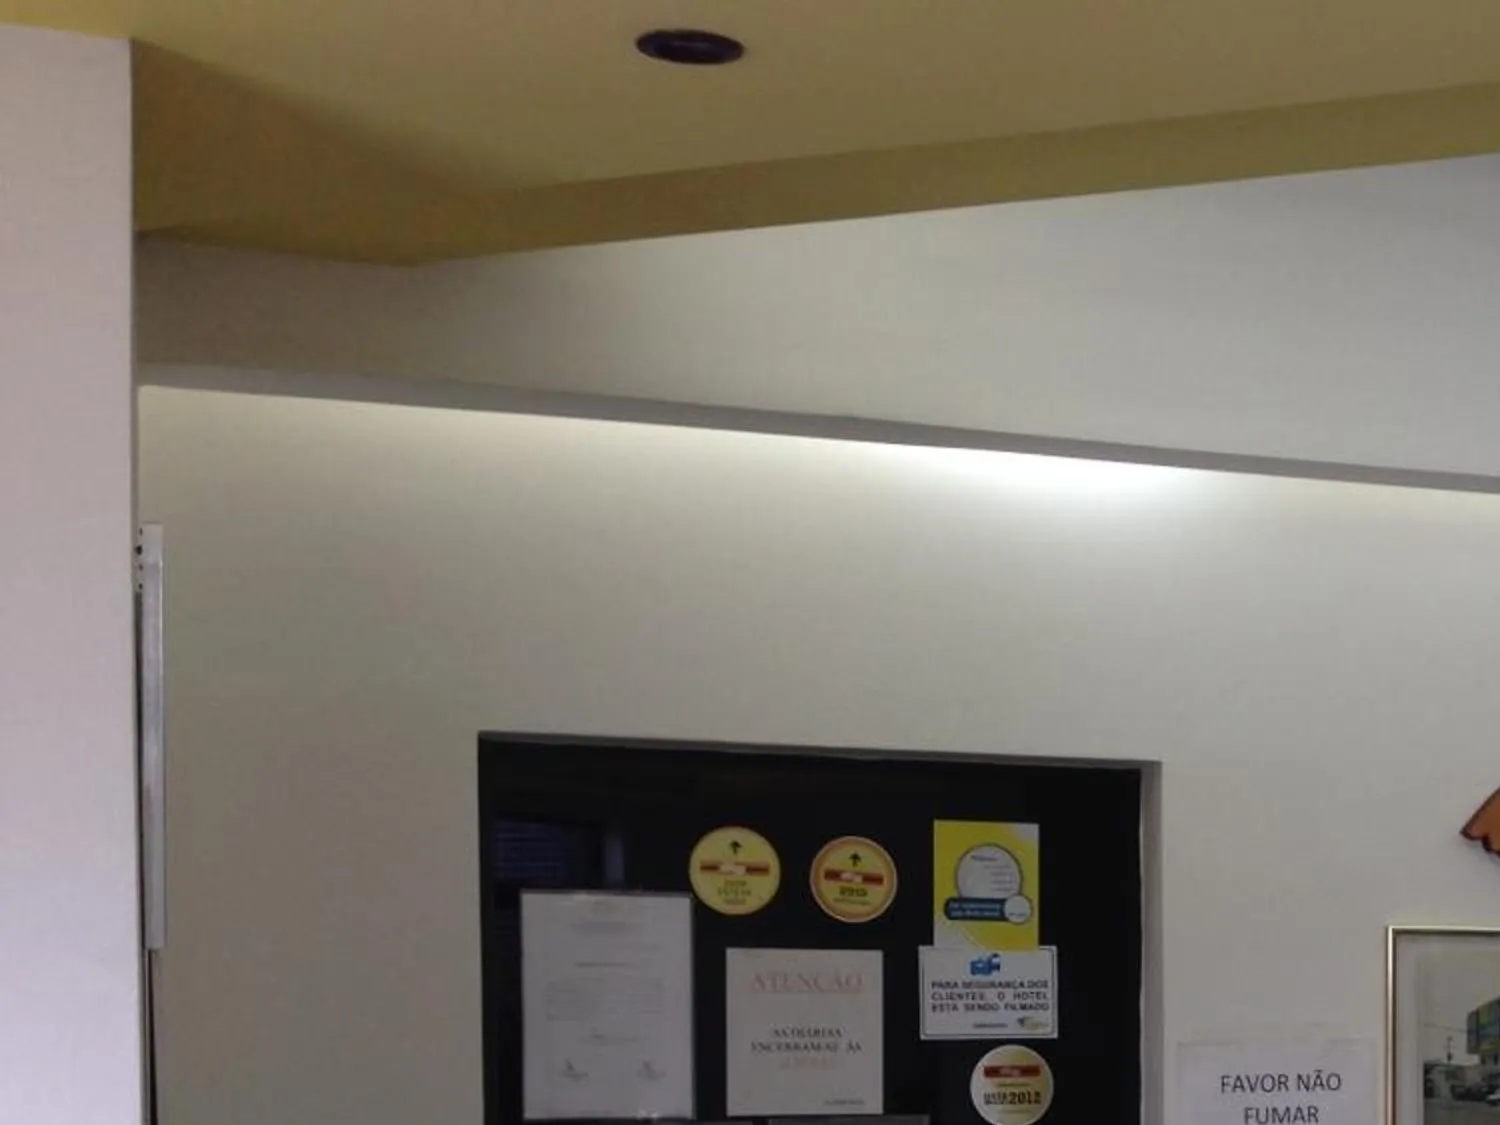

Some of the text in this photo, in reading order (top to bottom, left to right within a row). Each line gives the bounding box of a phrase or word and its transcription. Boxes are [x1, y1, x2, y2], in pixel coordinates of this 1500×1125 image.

[931, 979, 1048, 990] PARA SEGURANÇA DOS
[997, 991, 1005, 1001] O
[1013, 990, 1048, 1000] HOTEL
[963, 1002, 999, 1011] SENDO
[1004, 1002, 1049, 1011] FILMADO
[1220, 1069, 1342, 1094] FAVOR NÃO
[1243, 1105, 1319, 1125] FUMAR
